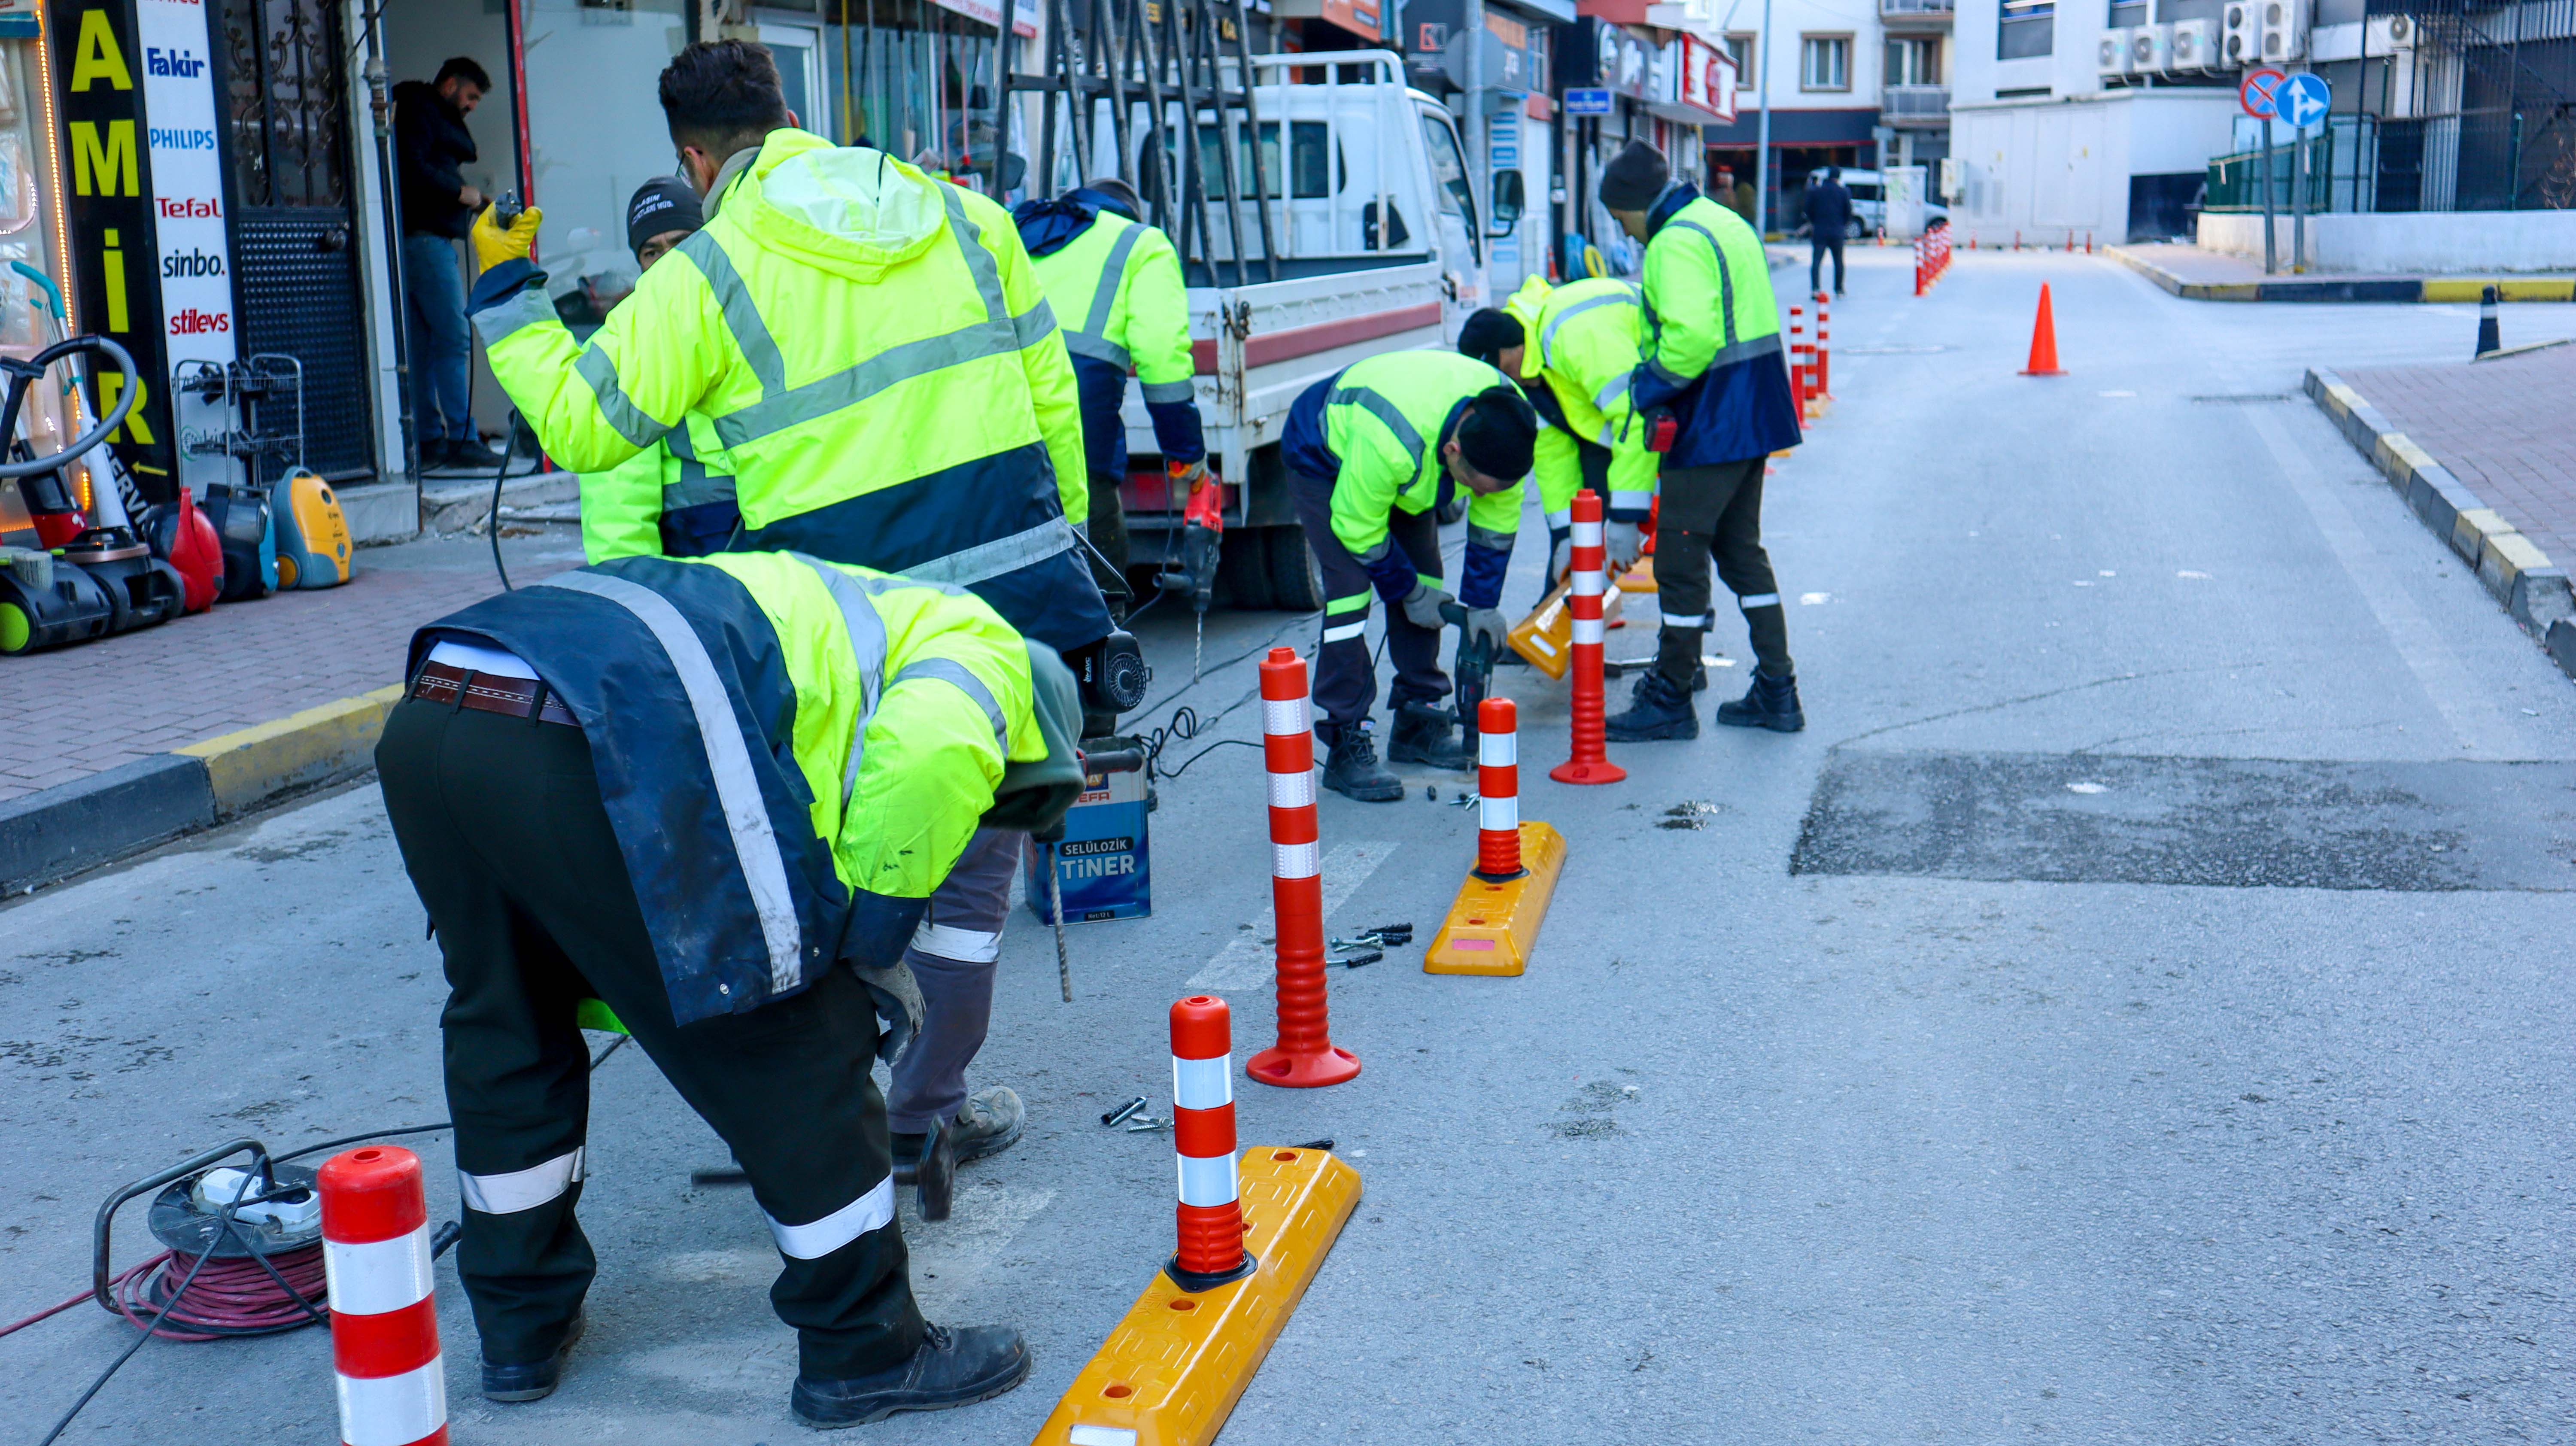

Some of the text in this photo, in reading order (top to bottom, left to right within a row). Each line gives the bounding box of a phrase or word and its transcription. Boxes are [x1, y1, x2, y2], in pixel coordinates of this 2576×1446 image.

[147, 48, 205, 79] Fakir
[150, 128, 215, 149] PHILIPS
[155, 198, 222, 218] Tefal
[170, 308, 229, 335] stilevs
[1065, 838, 1127, 855] SELÜLOZİK
